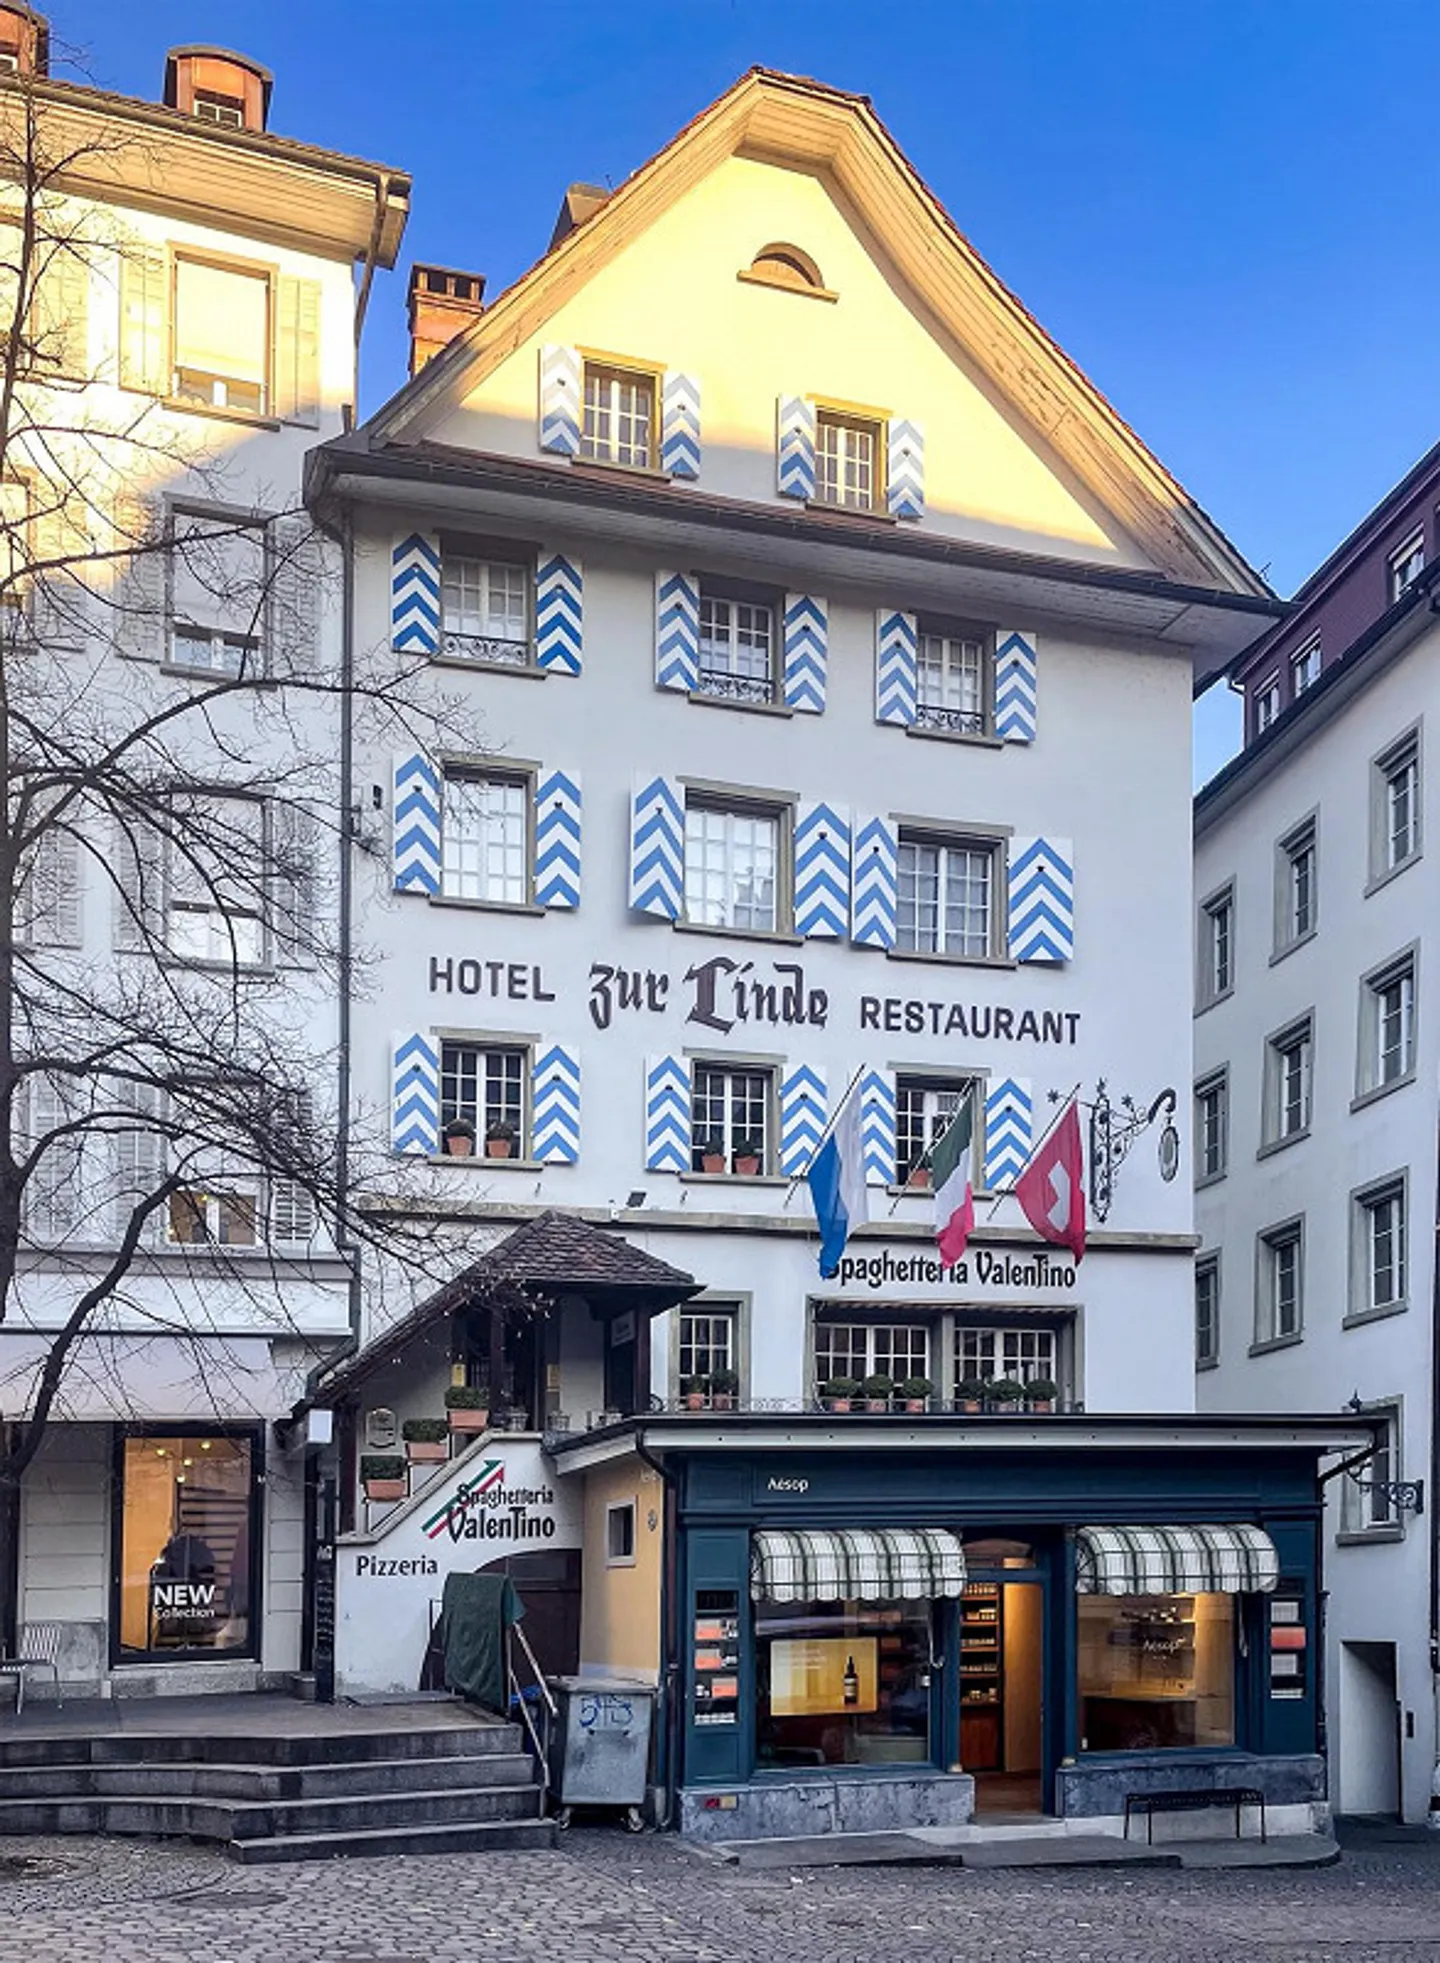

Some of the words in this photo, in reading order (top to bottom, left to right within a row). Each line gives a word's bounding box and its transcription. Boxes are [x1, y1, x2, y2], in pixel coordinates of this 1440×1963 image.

[428, 956, 556, 1002] HOTEL
[588, 961, 669, 1030] zur
[682, 955, 829, 1035] Linde
[860, 995, 1081, 1045] RESTAURANT
[456, 1482, 554, 1509] Spaghetteria
[356, 1555, 438, 1576] Pizzeria
[154, 1584, 216, 1606] NEW
[154, 1606, 216, 1619] Collection
